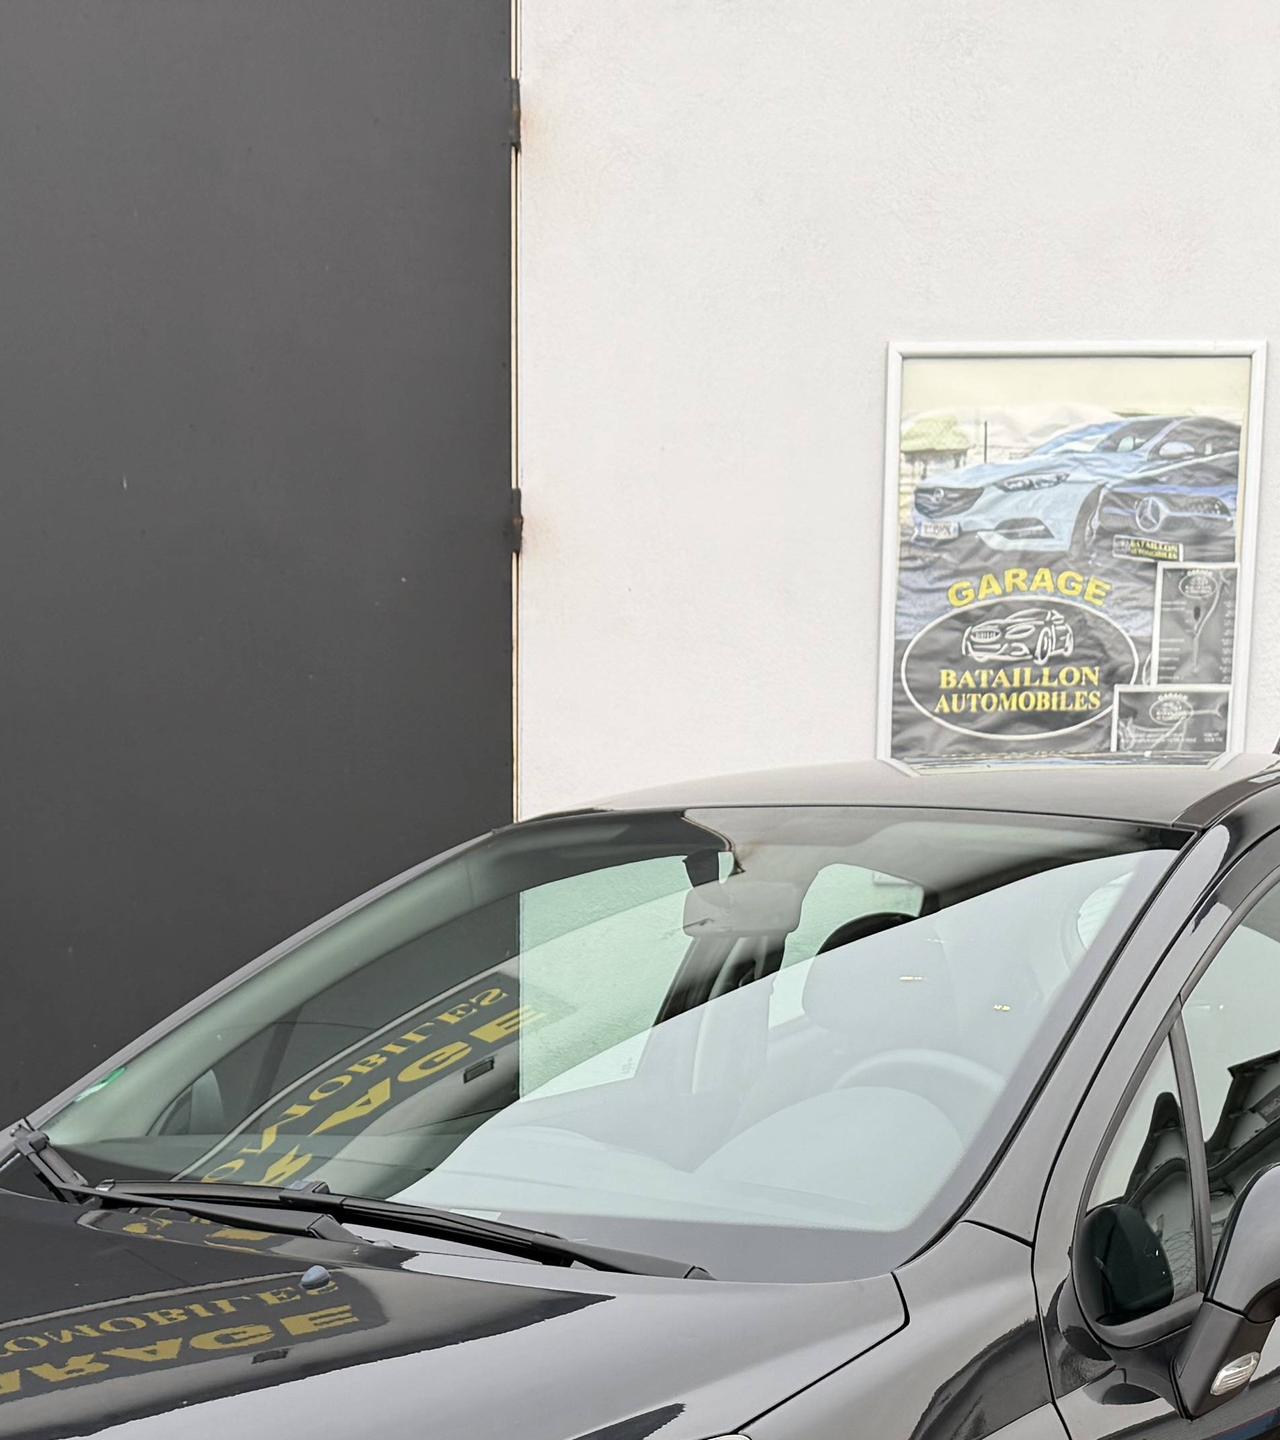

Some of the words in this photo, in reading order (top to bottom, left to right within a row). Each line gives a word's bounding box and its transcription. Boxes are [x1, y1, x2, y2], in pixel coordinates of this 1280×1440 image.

[947, 567, 1112, 609] GARAGE
[939, 666, 1100, 690] BATAILLON
[934, 690, 1101, 714] AUTOMOBILES
